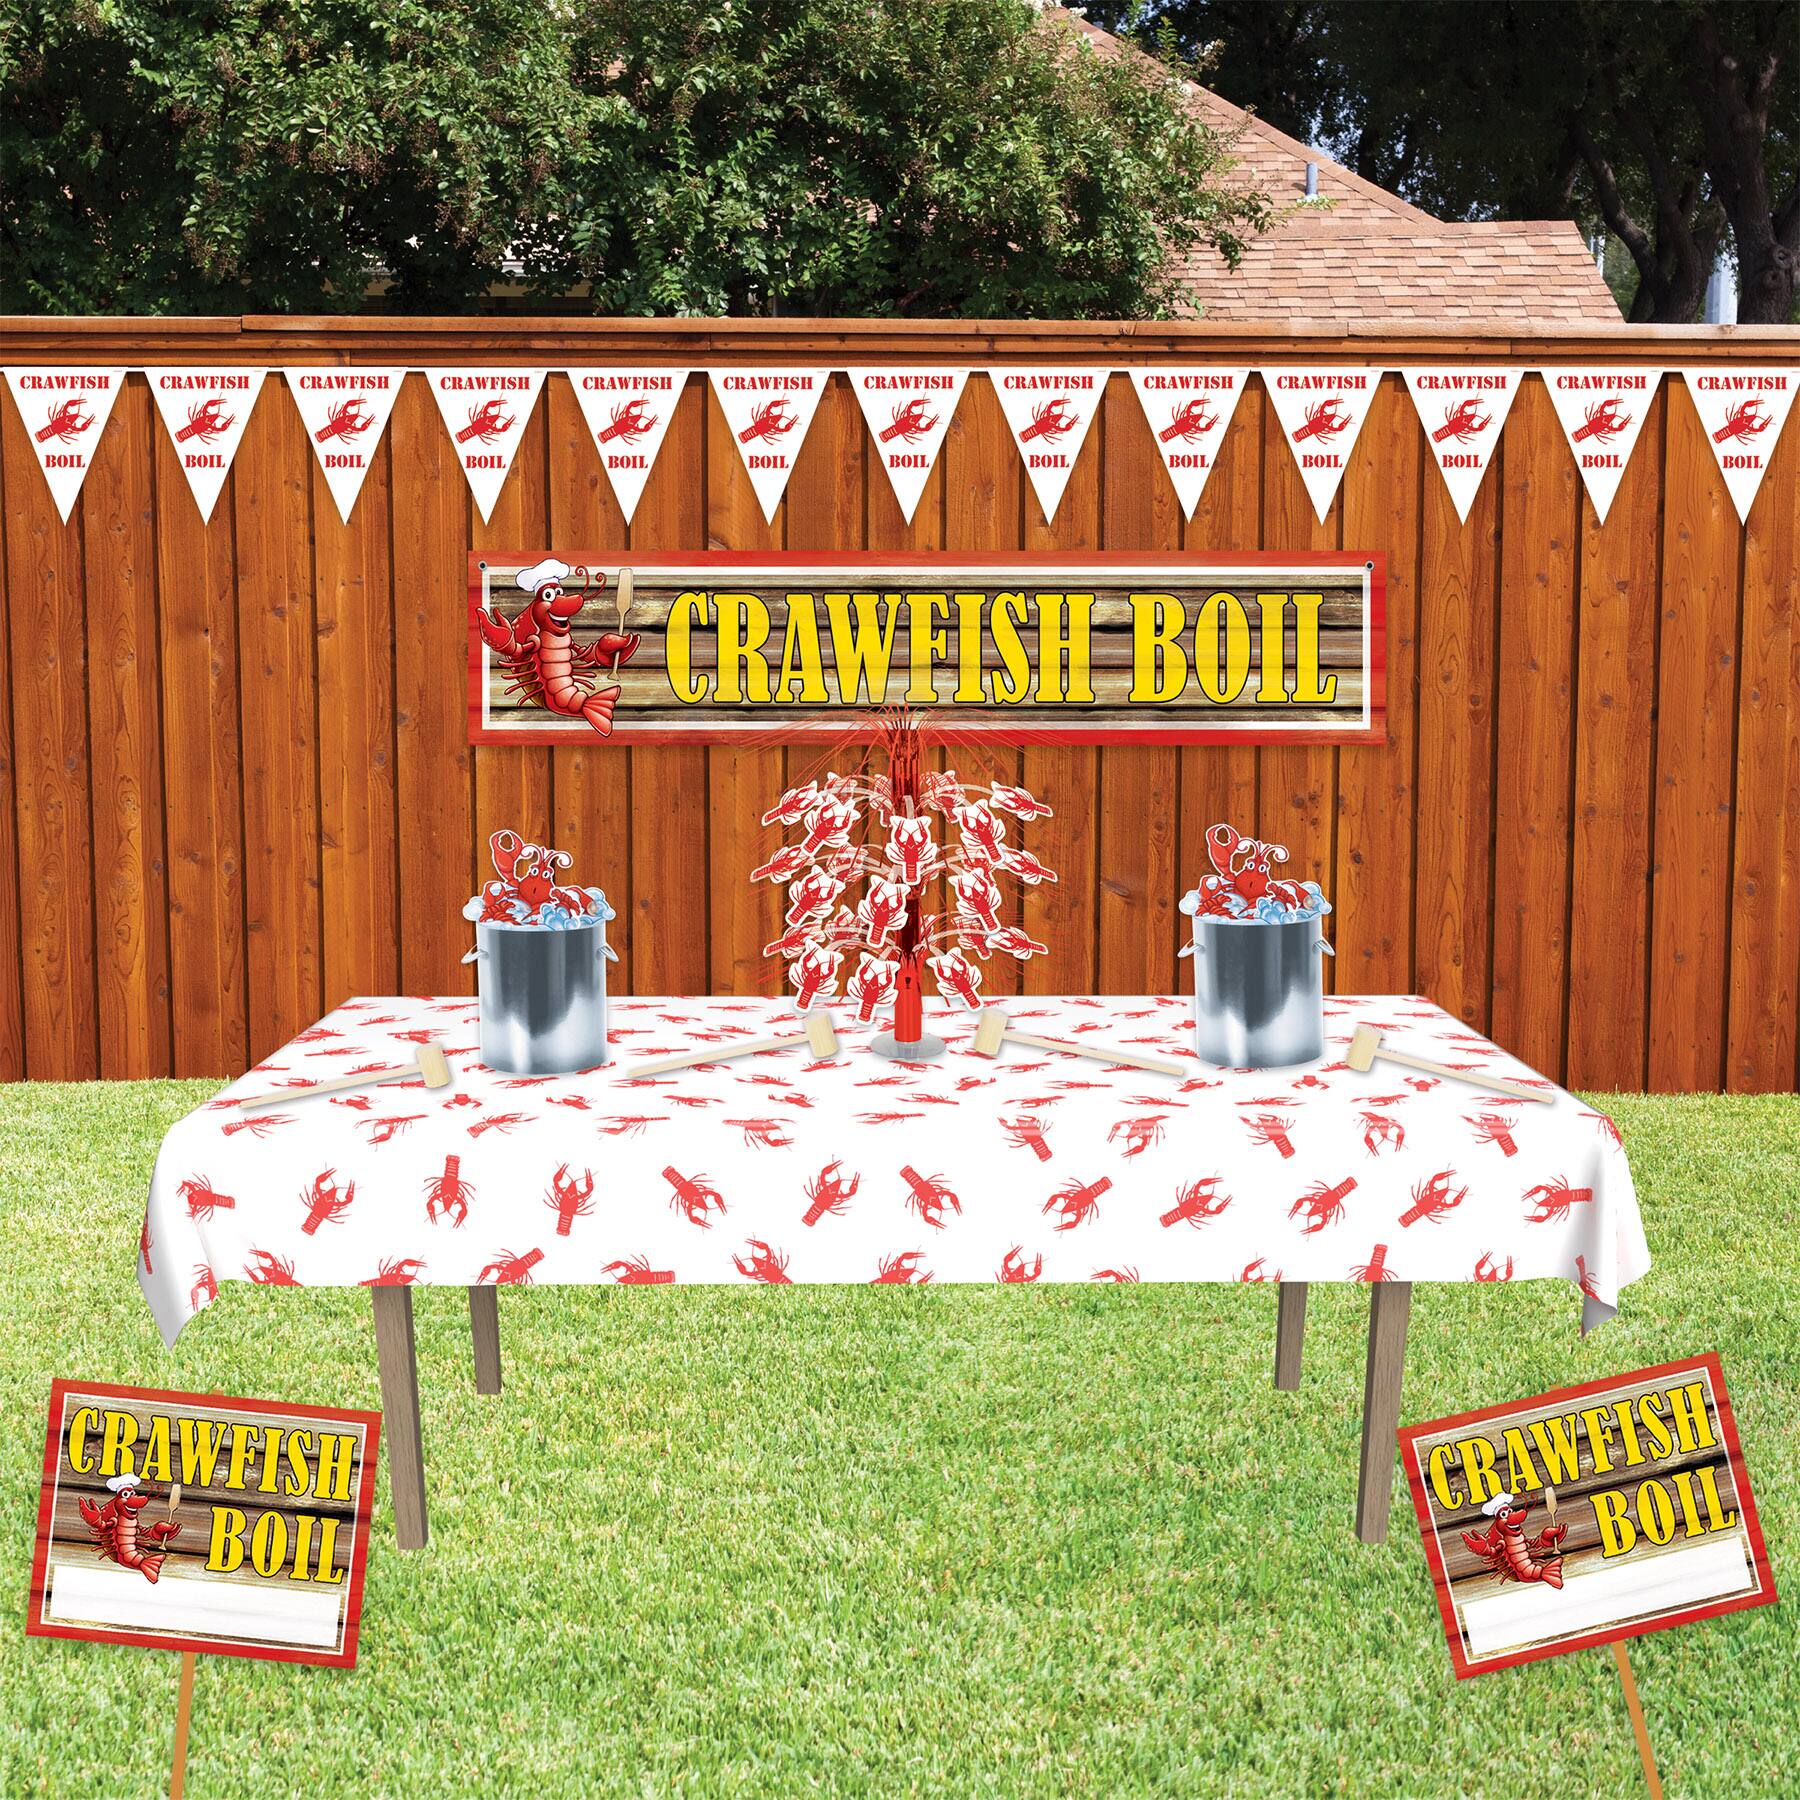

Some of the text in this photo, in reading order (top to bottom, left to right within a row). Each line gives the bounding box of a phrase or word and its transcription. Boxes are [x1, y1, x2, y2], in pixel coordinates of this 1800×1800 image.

[19, 375, 110, 390] CRAWFISH
[159, 375, 250, 390] CRAWFISH
[299, 375, 390, 390] CRAWFISH
[440, 376, 530, 391] CRAWFISH
[582, 376, 673, 391] CRAWFISH
[722, 376, 814, 391] CRAWFISH
[863, 375, 954, 390] CRAWFISH
[1003, 375, 1094, 390] CRAWFISH
[1143, 375, 1234, 390] CRAWFISH
[1276, 375, 1367, 390] CRAWFISH
[1416, 375, 1507, 390] CRAWFISH
[1556, 375, 1647, 390] CRAWFISH
[1697, 376, 1787, 391] CRAWFISH
[44, 454, 86, 468] BOIL
[184, 454, 226, 468] BOIL
[324, 454, 366, 468] BOIL
[465, 455, 507, 469] BOIL
[607, 455, 649, 469] BOIL
[747, 455, 789, 469] BOIL
[888, 454, 930, 468] BOIL
[1028, 454, 1070, 468] BOIL
[1168, 454, 1210, 468] BOIL
[1301, 454, 1343, 468] BOIL
[1441, 454, 1483, 468] BOIL
[1581, 454, 1623, 468] BOIL
[1722, 455, 1764, 469] BOIL
[664, 591, 1338, 704] CRAWFISH BOIL
[1427, 1381, 1717, 1511] CRAWFISH
[67, 1406, 358, 1502] CRAWFISH
[1588, 1466, 1736, 1559] BOIL
[204, 1506, 345, 1584] BOIL
